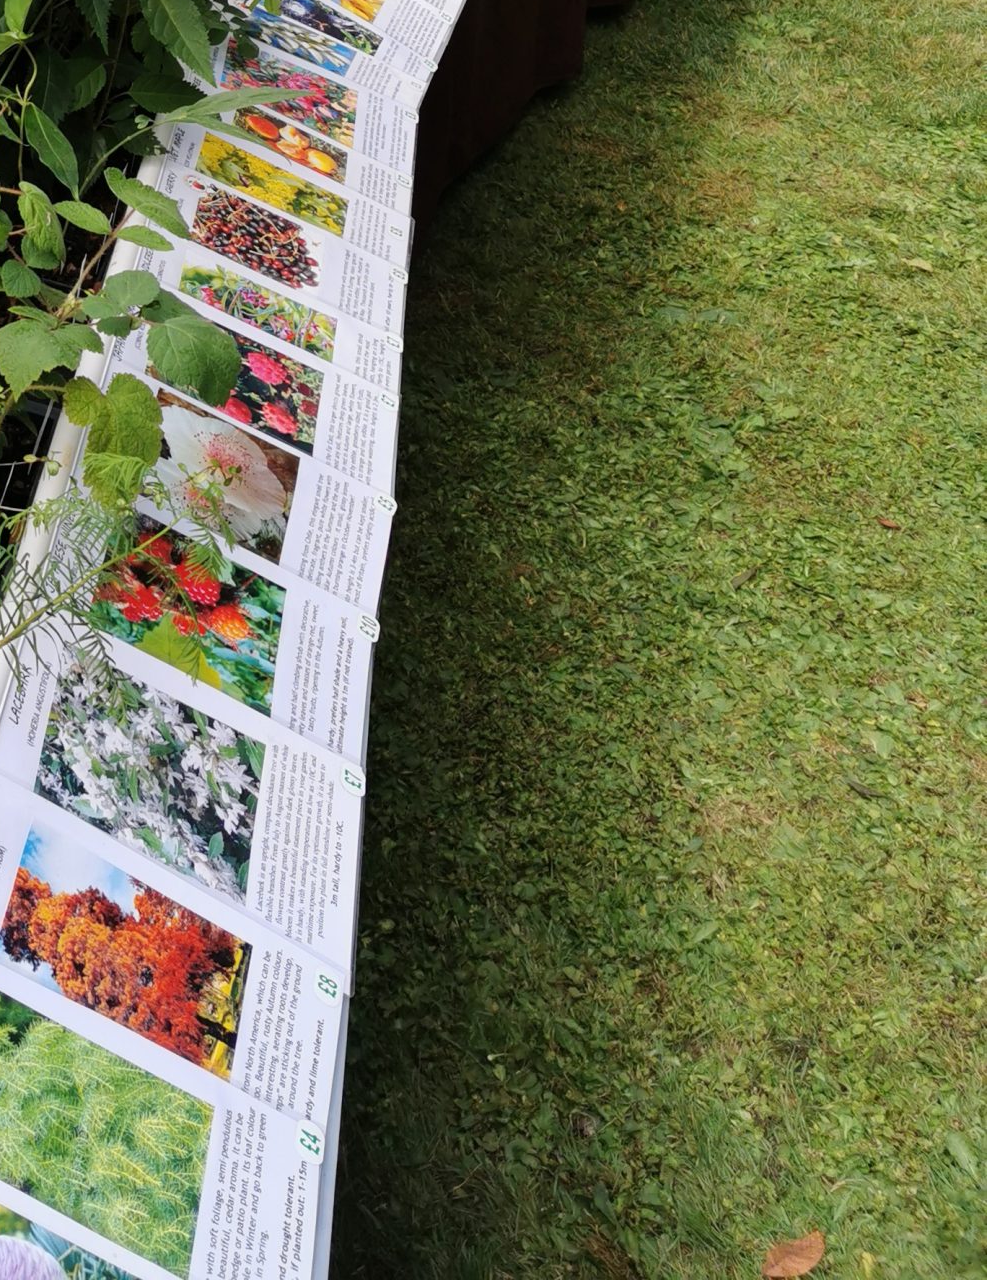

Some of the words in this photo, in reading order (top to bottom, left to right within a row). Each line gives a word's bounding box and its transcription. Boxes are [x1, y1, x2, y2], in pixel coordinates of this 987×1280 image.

[359, 615, 378, 639] £10
[8, 662, 34, 725] LACEBARK
[344, 769, 363, 789] £7
[335, 820, 344, 840] -10C.
[334, 841, 341, 850] to
[332, 850, 342, 875] hardy
[331, 877, 340, 892] tall,
[330, 893, 337, 907] 3m
[262, 950, 271, 962] be
[272, 949, 283, 980] colours.
[261, 962, 269, 979] can
[280, 957, 293, 991] develop,
[292, 963, 302, 994] ground
[255, 979, 266, 1004] which
[265, 980, 277, 1015] Autumn
[317, 974, 338, 999] £8
[278, 991, 287, 1014] roots
[289, 994, 298, 1009] the
[262, 1014, 273, 1037] rusty
[287, 1008, 295, 1020] of
[249, 1008, 263, 1045] America,
[272, 1014, 285, 1051] aerating
[286, 1021, 294, 1037] out
[312, 1019, 324, 1056] tolerant.
[244, 1045, 255, 1071] North
[254, 1040, 269, 1082] Beautiful,
[280, 1037, 293, 1072] sticking
[293, 1039, 303, 1059] tree.
[263, 1054, 279, 1103] interesting,
[290, 1060, 300, 1076] the
[308, 1057, 319, 1078] lime
[239, 1072, 251, 1094] from
[253, 1084, 261, 1100] oo.
[278, 1072, 287, 1088] are
[287, 1075, 298, 1109] around
[308, 1077, 316, 1097] and
[234, 1112, 243, 1125] be
[304, 1097, 315, 1121] ardy
[246, 1106, 255, 1137] colour
[258, 1112, 266, 1140] green
[217, 1108, 232, 1184] semi-pendulous
[234, 1126, 242, 1145] can
[242, 1136, 252, 1158] leaf
[256, 1141, 264, 1152] to
[299, 1128, 321, 1156] £4
[231, 1146, 240, 1155] It
[228, 1159, 239, 1192] aroma.
[241, 1159, 251, 1173] Its
[252, 1154, 263, 1178] back
[297, 1160, 307, 1191] 1-15m
[238, 1177, 249, 1207] plant.
[253, 1179, 261, 1193] go
[284, 1174, 295, 1218] tolerant.
[210, 1187, 224, 1225] foliage,
[224, 1193, 234, 1224] cedar
[250, 1193, 259, 1214] and
[297, 1194, 305, 1216] out:
[236, 1207, 245, 1236] patio
[245, 1214, 256, 1250] Winter
[209, 1227, 218, 1249] soft
[234, 1236, 241, 1249] or
[255, 1230, 269, 1265] Spring.
[279, 1220, 291, 1264] drought
[291, 1217, 303, 1262] planted
[205, 1251, 215, 1274] with
[216, 1228, 232, 1279] beautiful,
[230, 1251, 241, 1280] edge
[243, 1254, 252, 1264] in
[254, 1266, 263, 1278] in
[277, 1264, 286, 1278] nd
